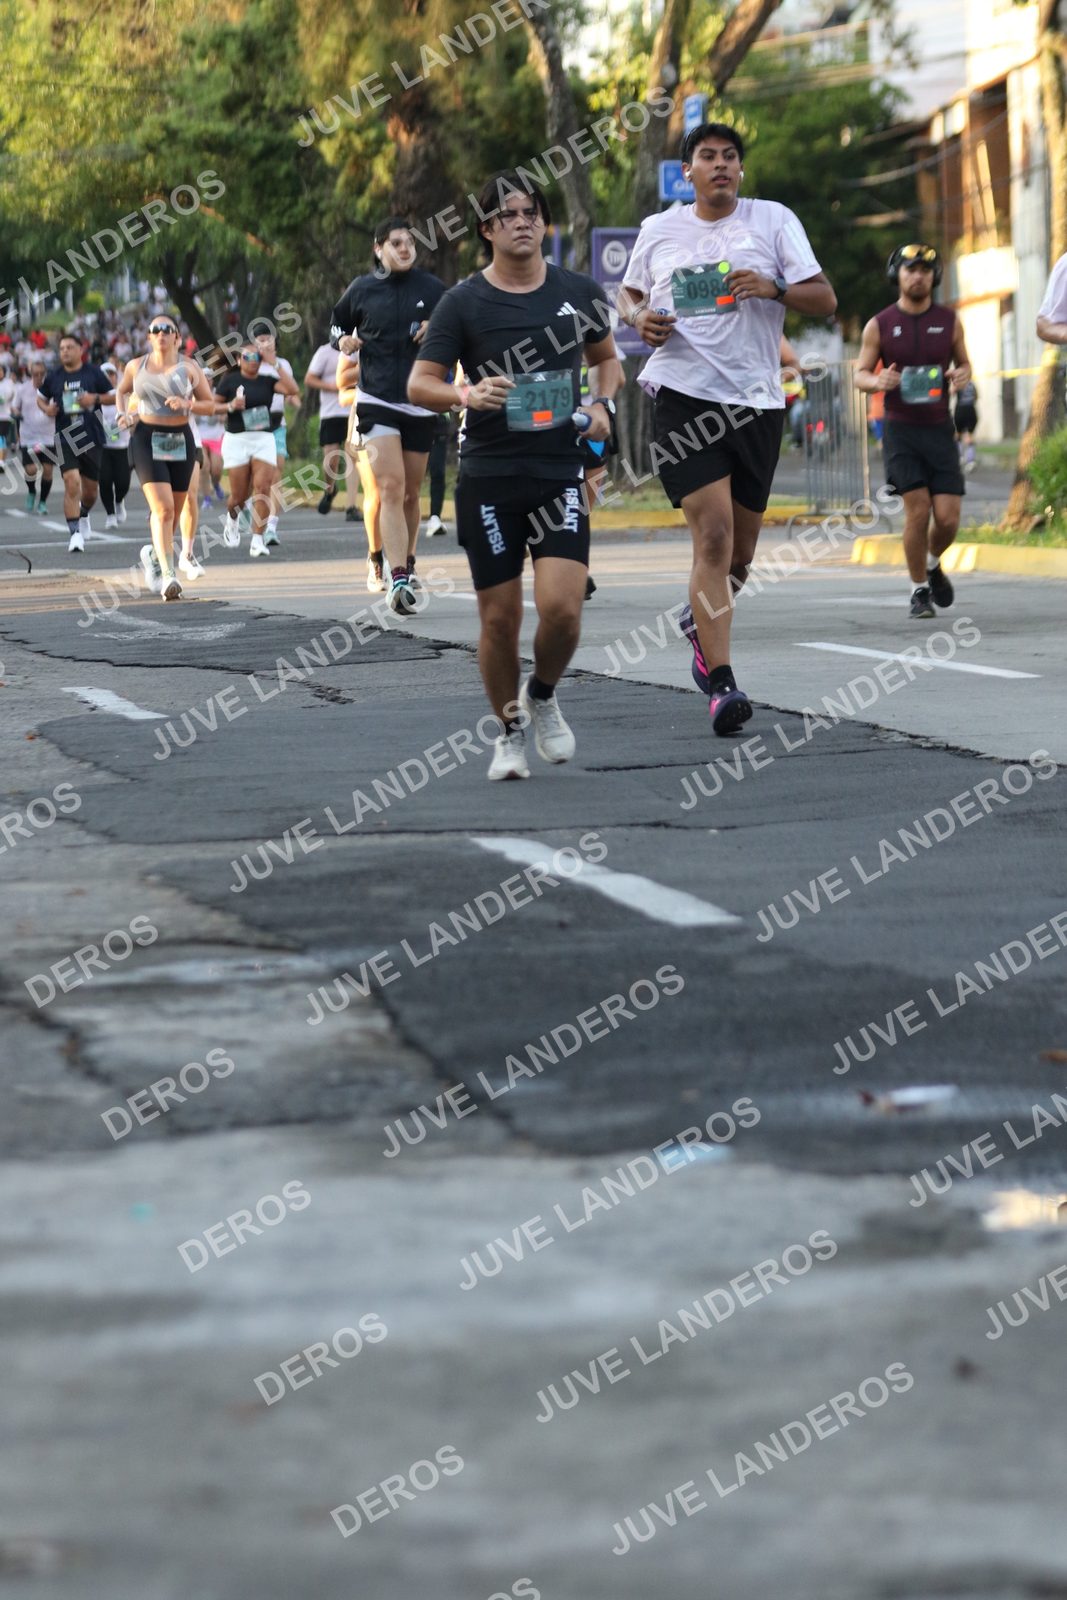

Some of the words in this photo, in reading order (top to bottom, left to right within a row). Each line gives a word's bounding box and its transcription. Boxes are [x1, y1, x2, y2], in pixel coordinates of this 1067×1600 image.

[525, 386, 571, 412] 2179
[480, 504, 506, 555] RSLNT
[563, 487, 580, 532] RSLNT
